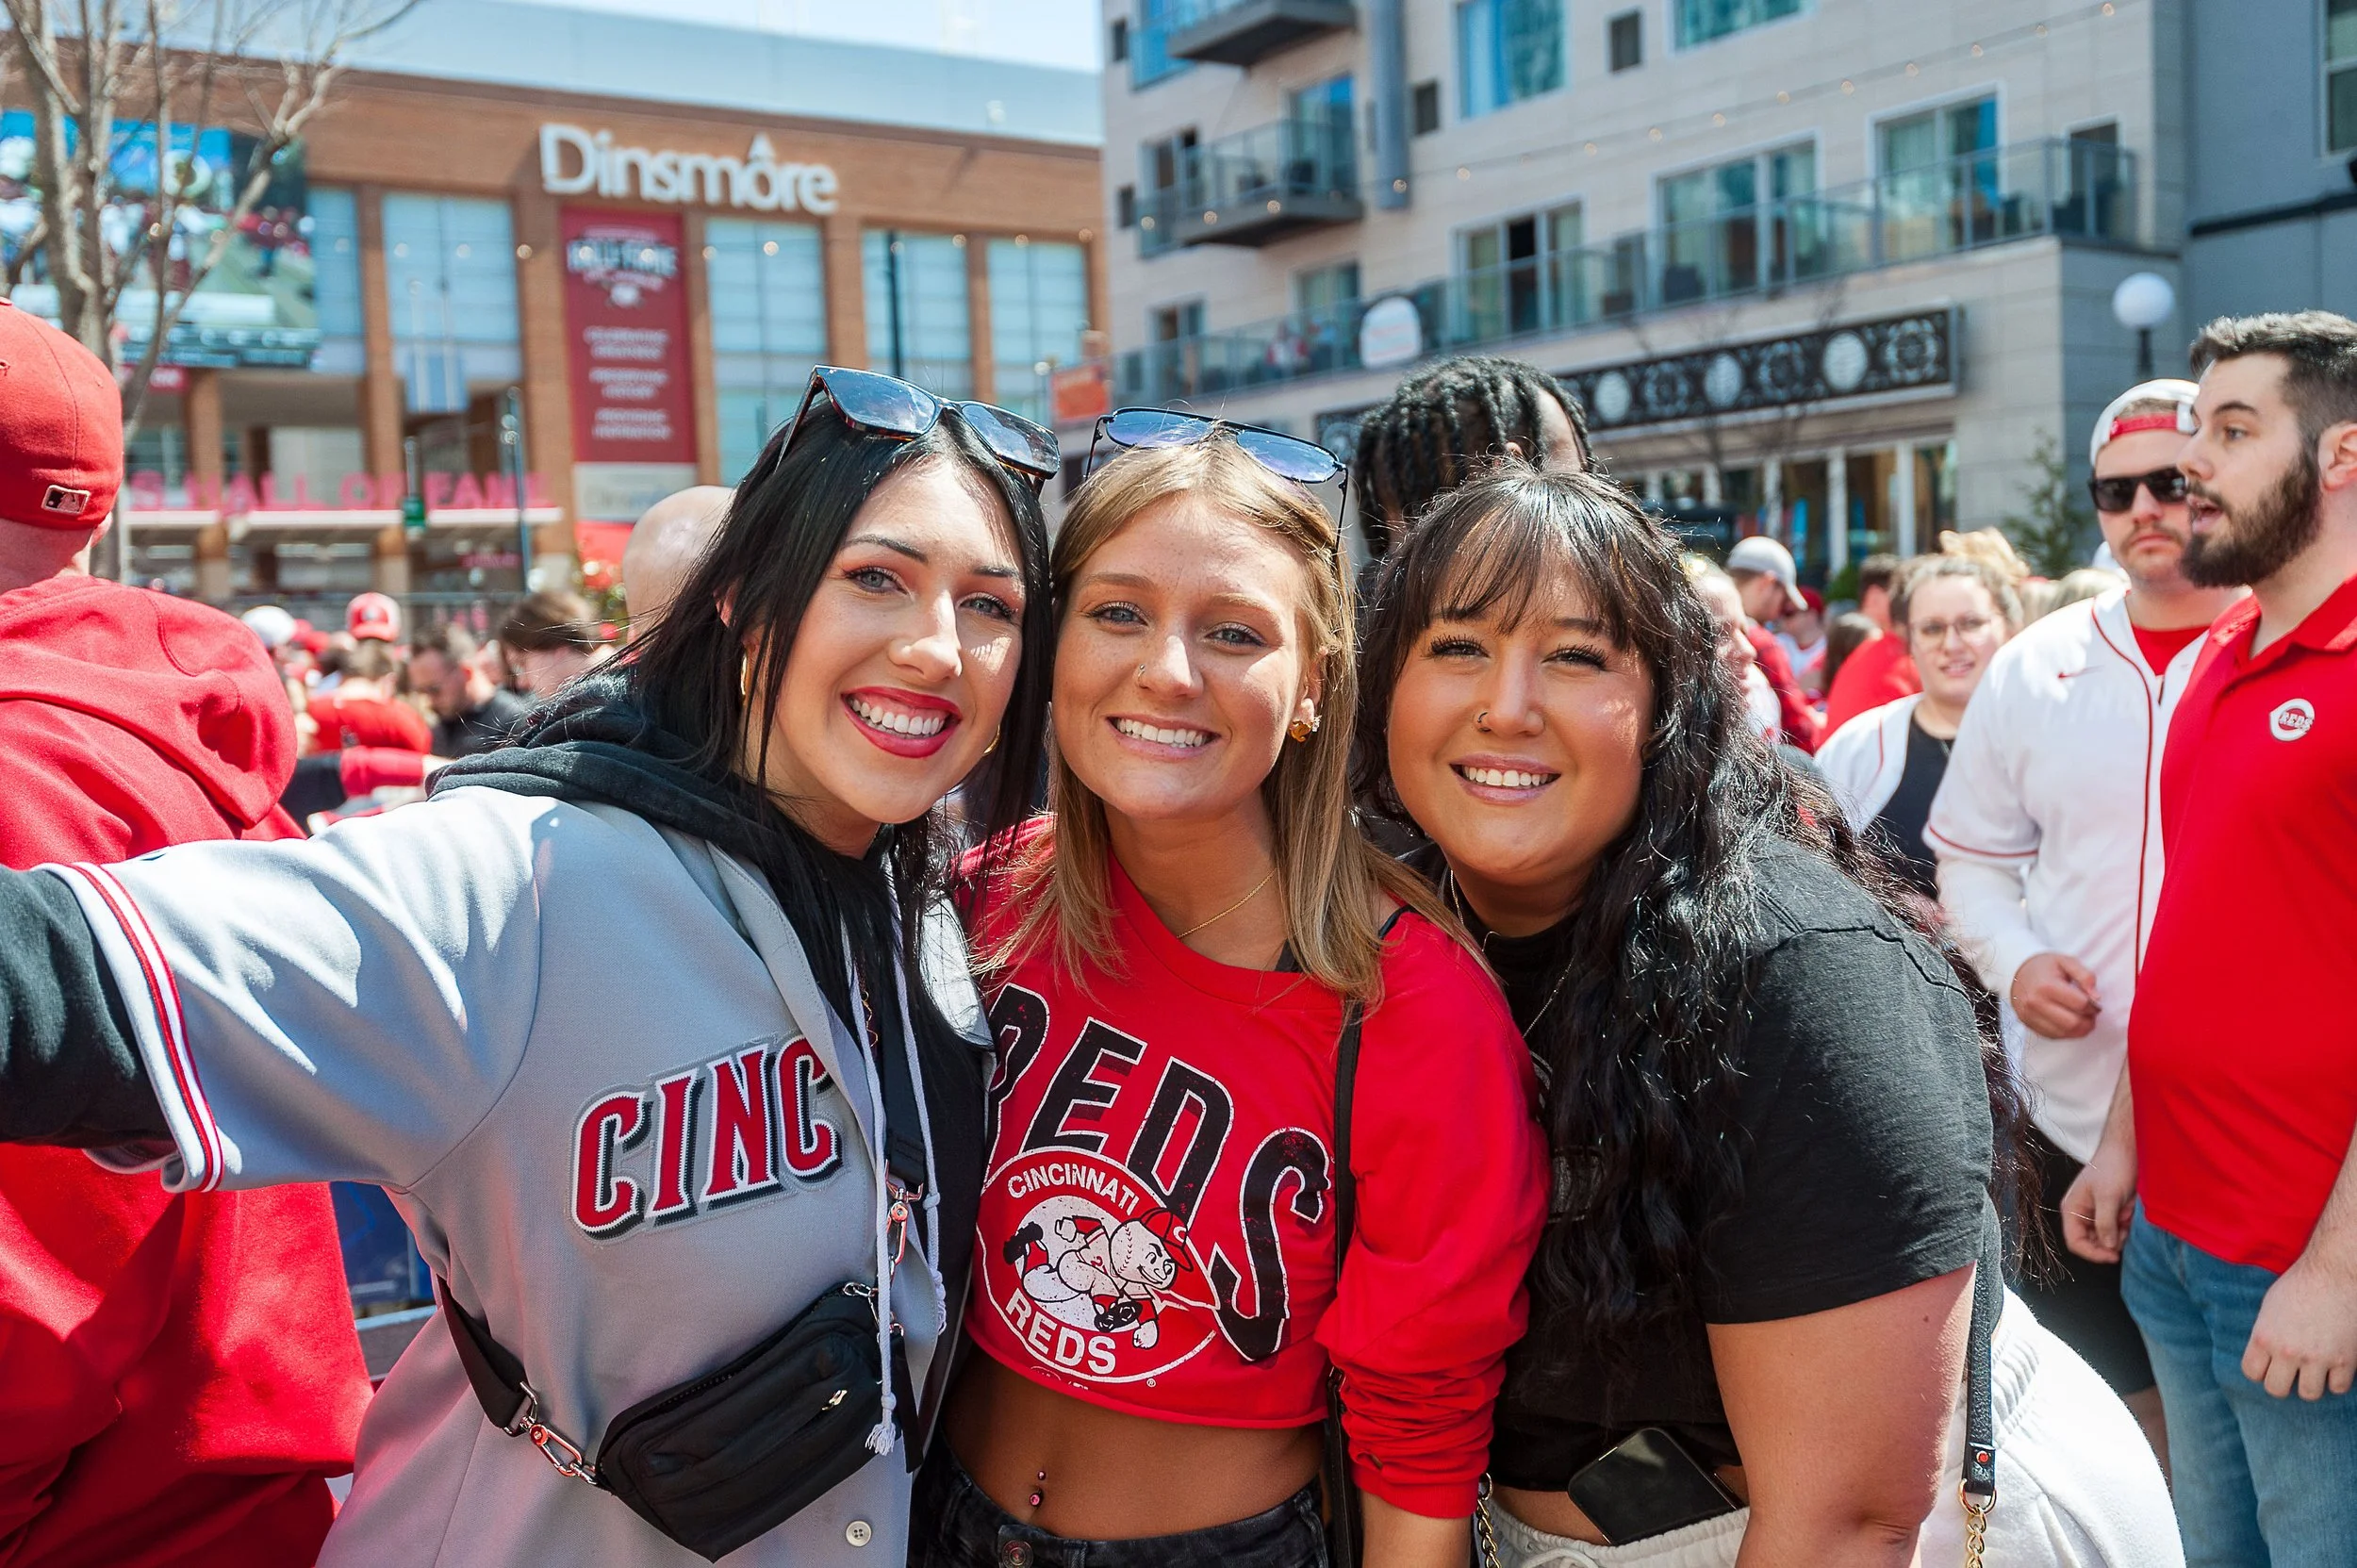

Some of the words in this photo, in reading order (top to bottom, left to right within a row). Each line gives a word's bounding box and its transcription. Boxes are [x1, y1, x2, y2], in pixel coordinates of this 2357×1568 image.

[571, 1033, 844, 1241] CINC
[1008, 1163, 1140, 1216] CINCINNATI
[1005, 1288, 1116, 1375] REDS
